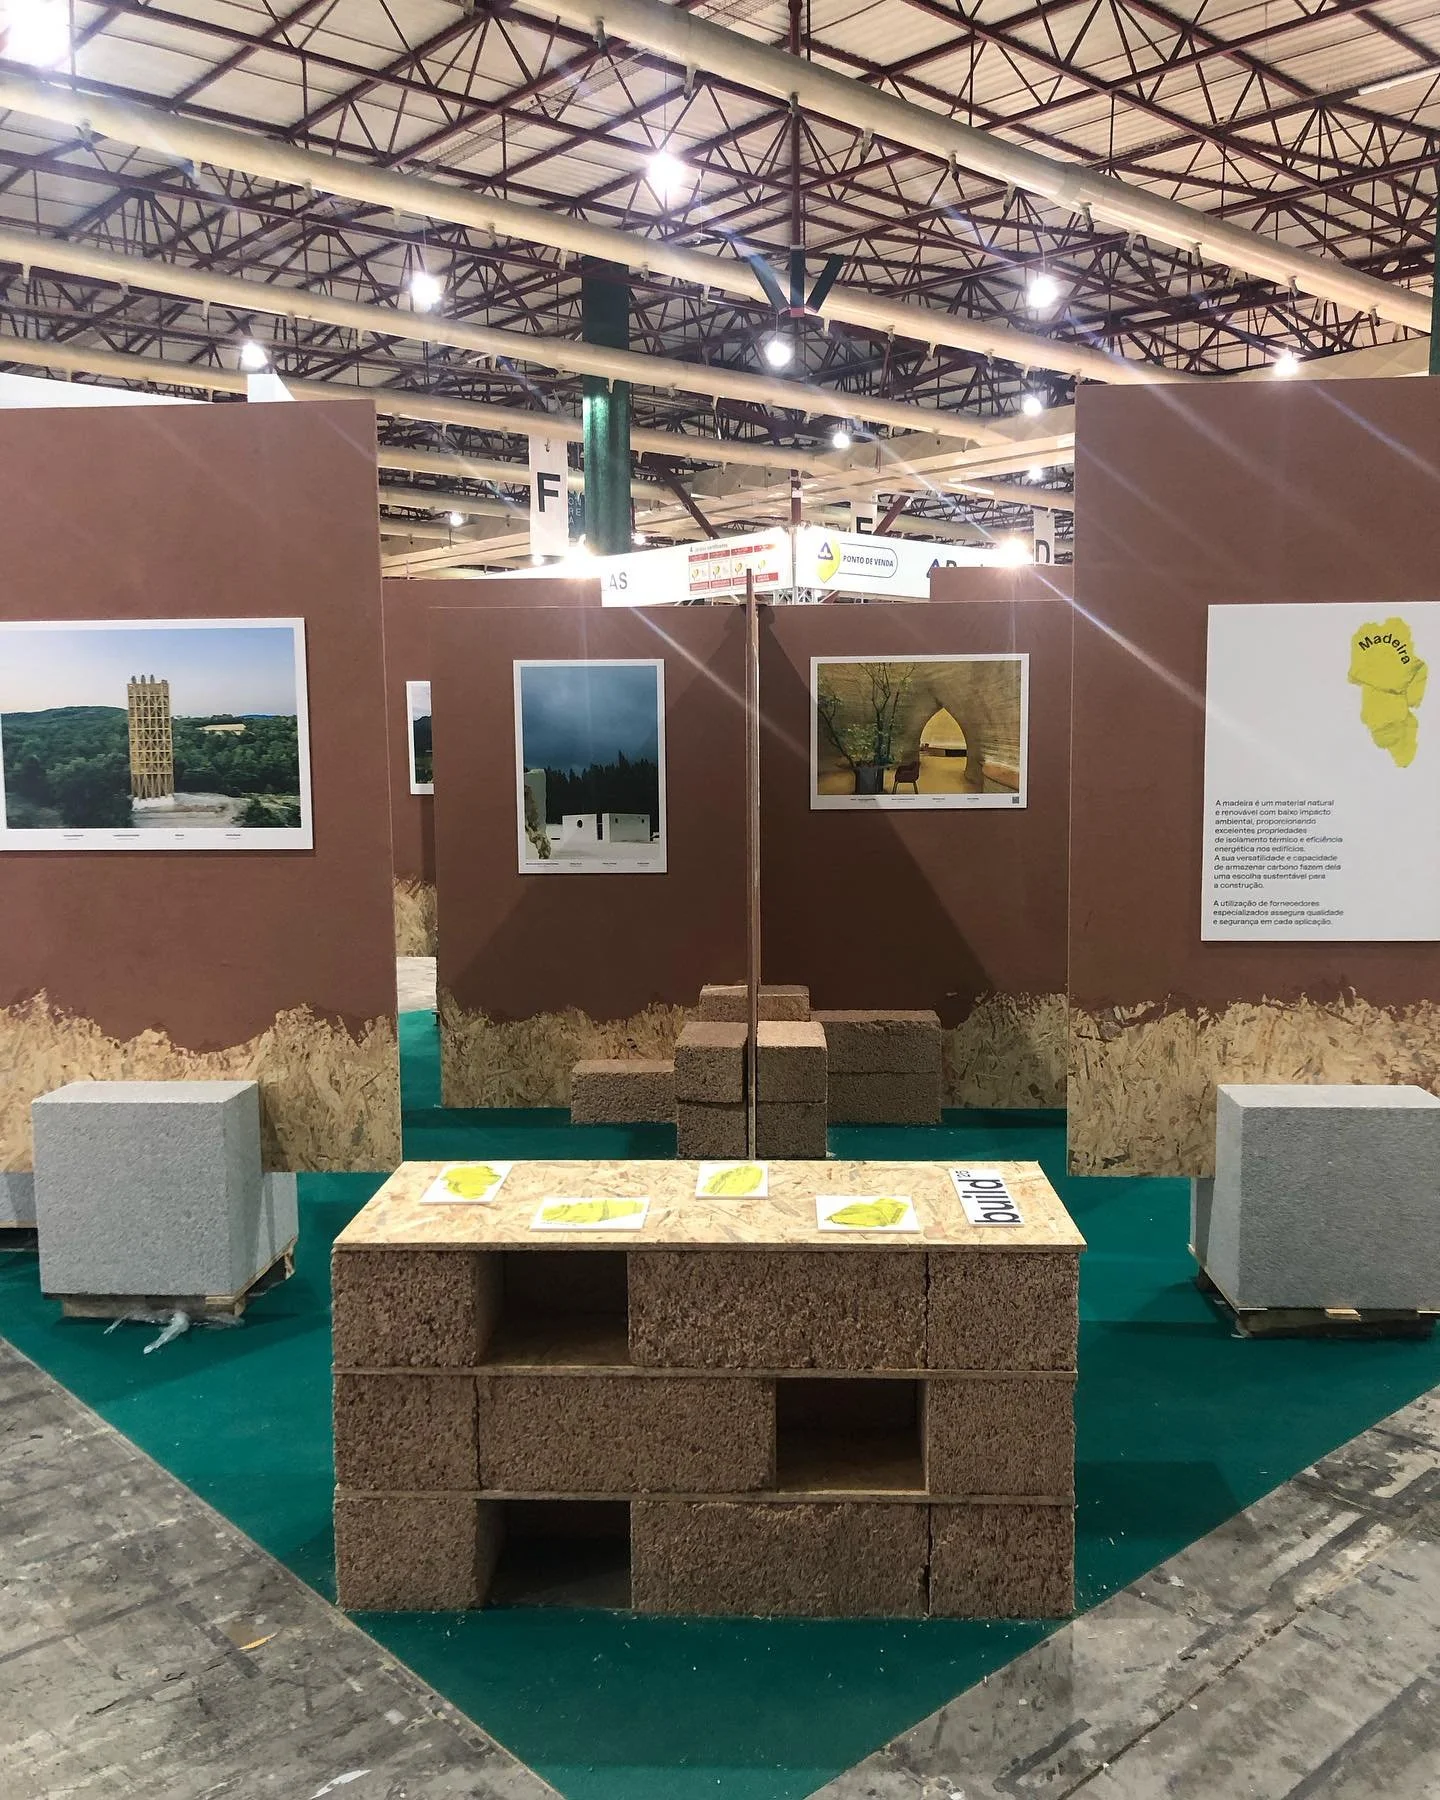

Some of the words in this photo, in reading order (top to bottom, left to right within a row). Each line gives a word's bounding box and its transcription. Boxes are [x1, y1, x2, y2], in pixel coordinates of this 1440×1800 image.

[537, 472, 560, 512] F
[1035, 539, 1051, 564] D
[843, 555, 865, 564] PONTO
[874, 559, 894, 567] VENDA
[601, 571, 628, 592] AS
[1358, 633, 1411, 665] Madeira
[1256, 827, 1307, 835] propriedades
[1220, 882, 1264, 890] construção.
[1220, 900, 1257, 908] utilização
[1213, 909, 1269, 917] especializados
[1306, 909, 1344, 917] qualidade
[1294, 919, 1332, 927] aplicação.
[958, 1179, 1021, 1223] build
